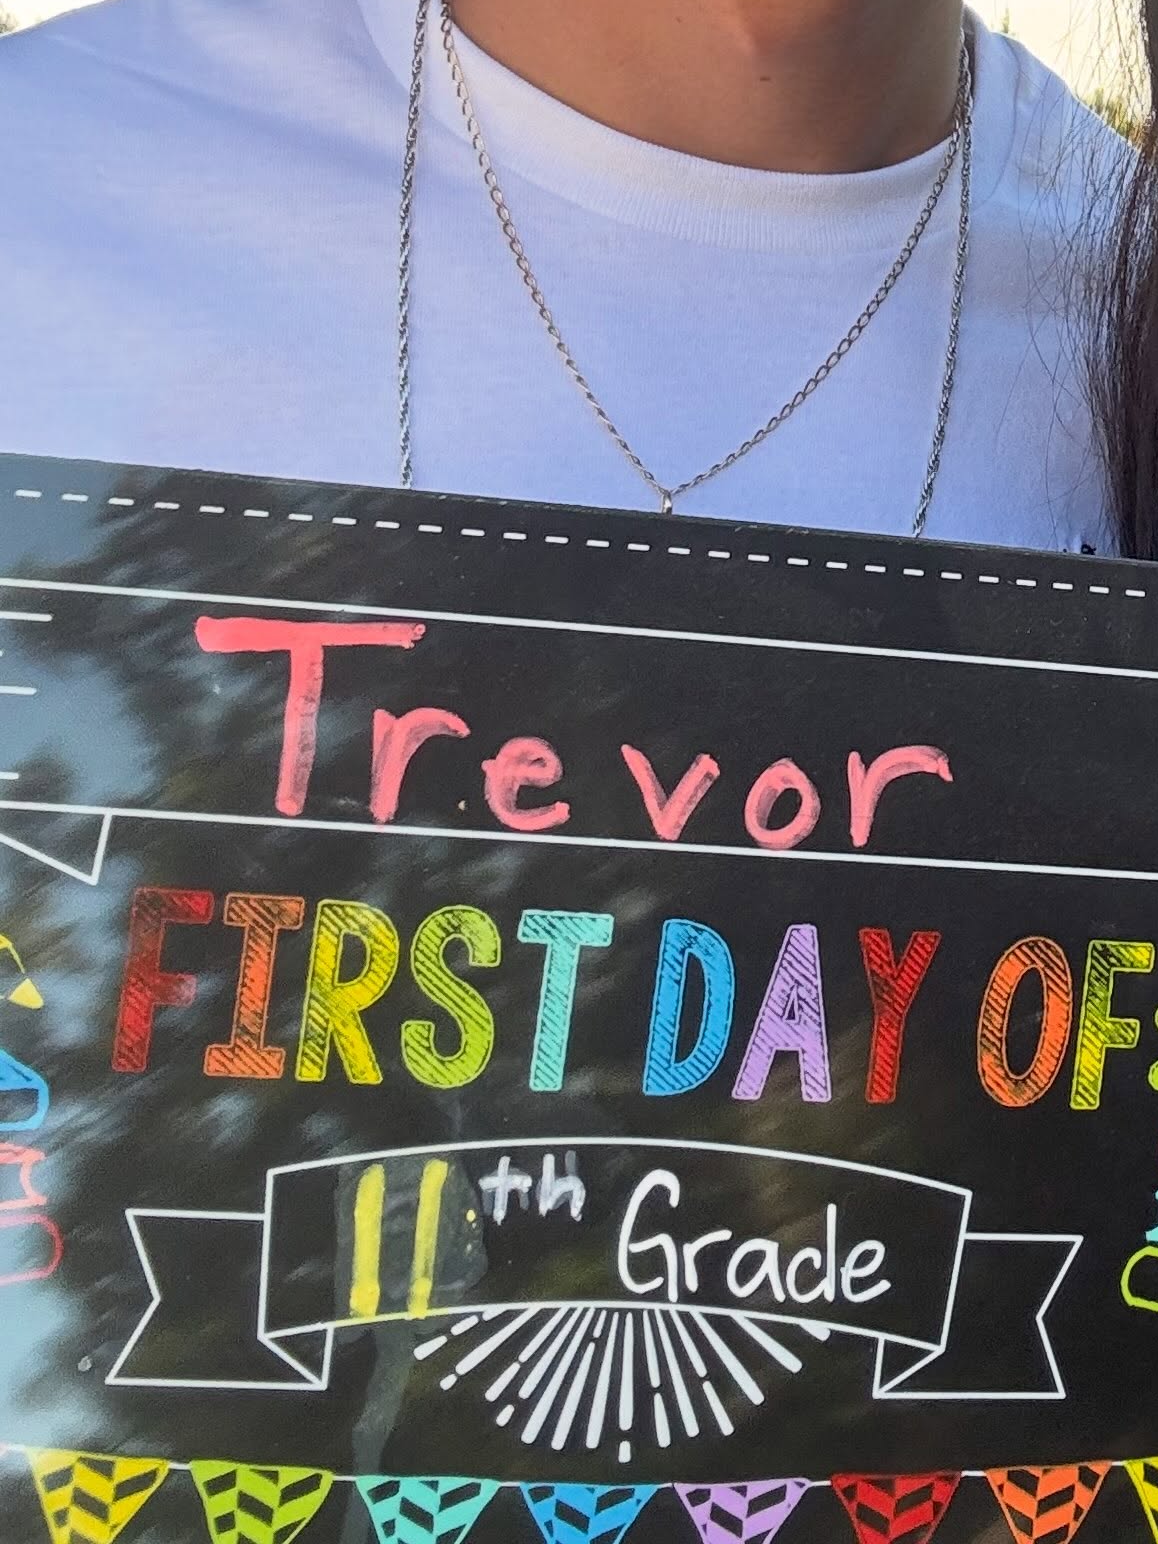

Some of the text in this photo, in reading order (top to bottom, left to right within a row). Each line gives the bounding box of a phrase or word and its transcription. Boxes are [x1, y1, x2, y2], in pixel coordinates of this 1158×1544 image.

[194, 615, 954, 851] Trevor
[110, 886, 614, 1090] FIRST
[642, 918, 942, 1104] DAY
[616, 1168, 892, 1304] Grade
